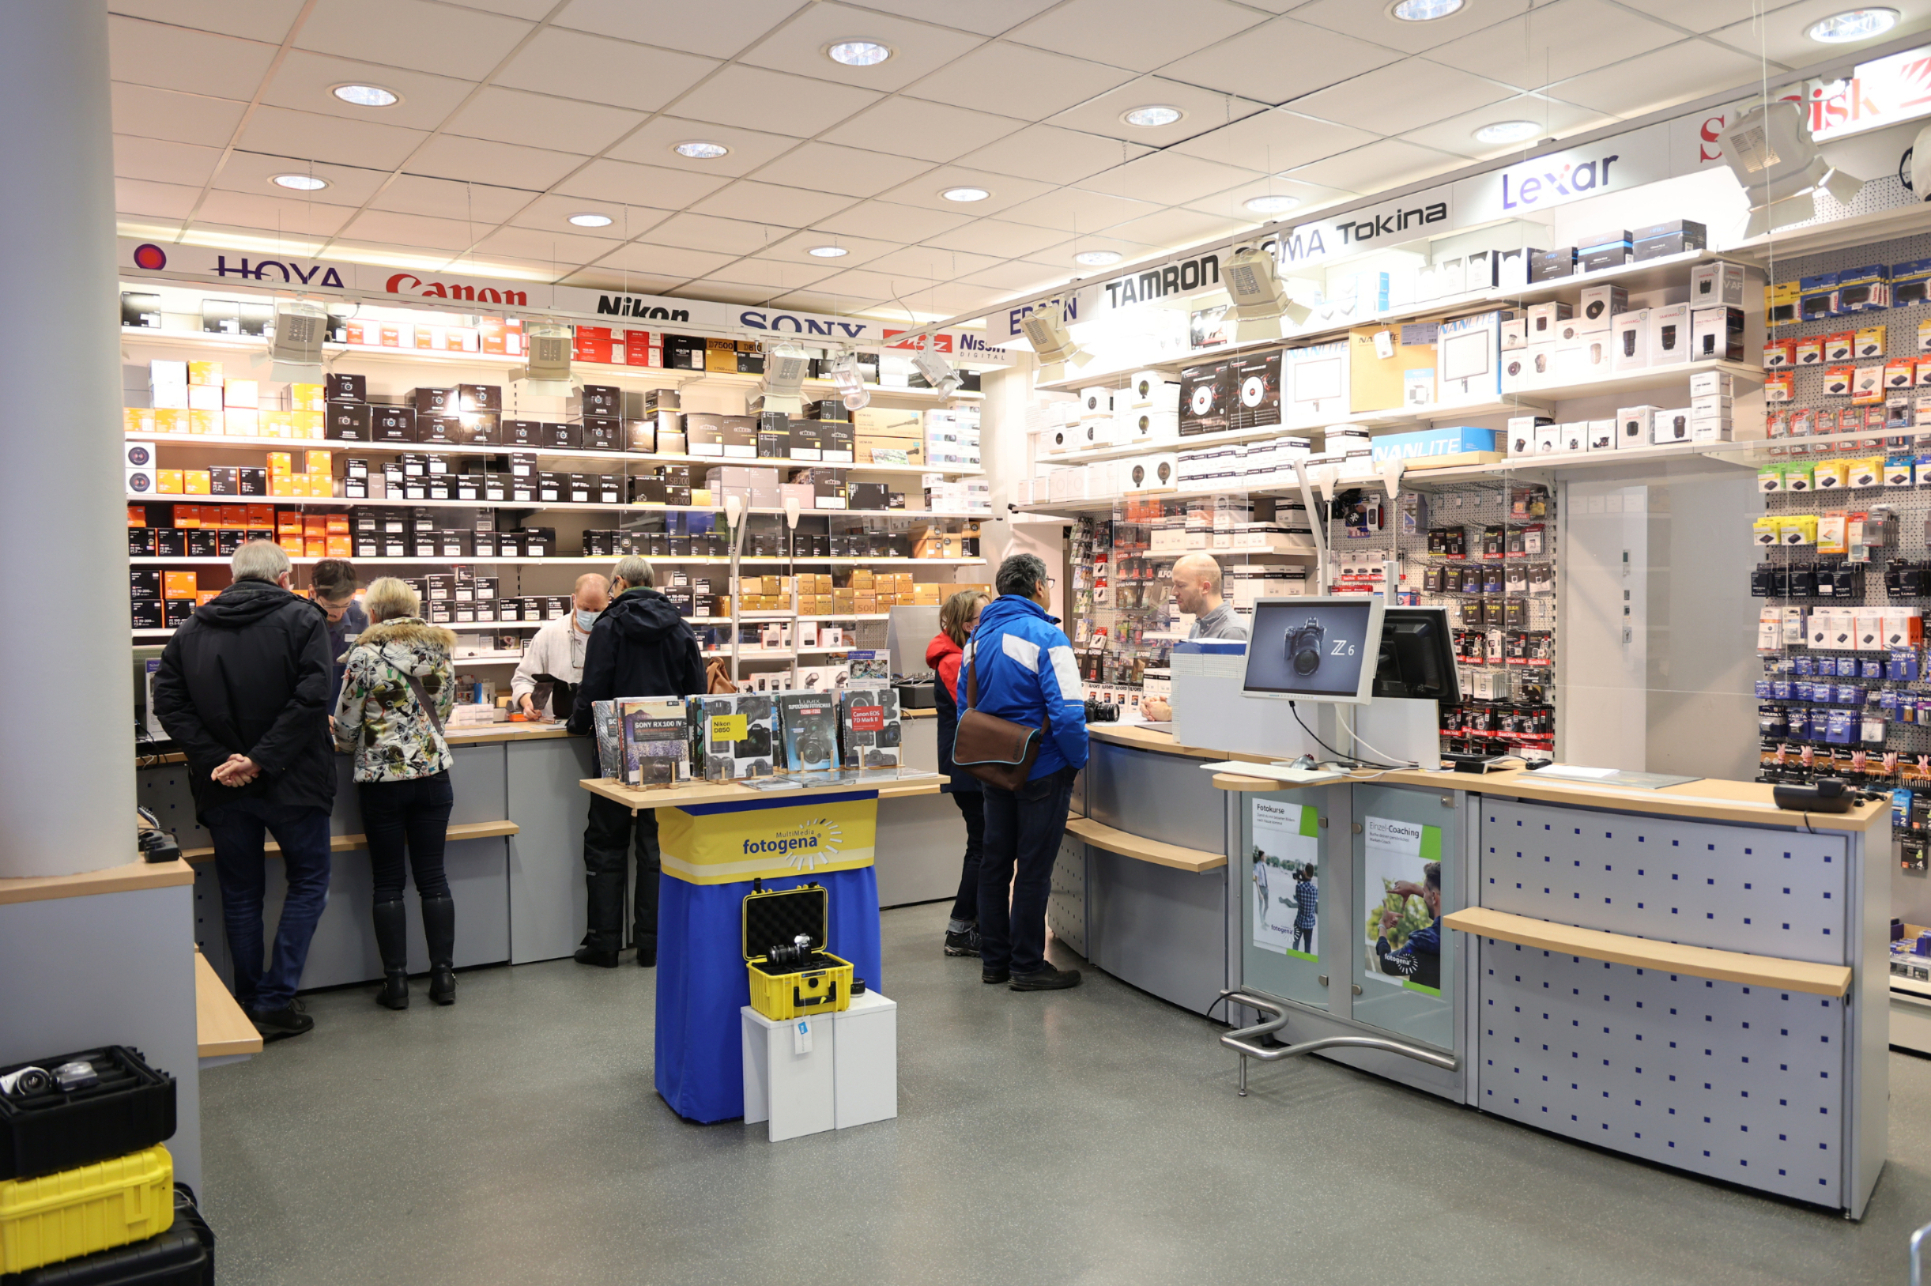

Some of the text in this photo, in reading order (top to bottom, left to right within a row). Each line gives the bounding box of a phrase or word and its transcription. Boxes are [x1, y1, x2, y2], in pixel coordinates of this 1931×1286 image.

[1502, 154, 1619, 210] Lexar
[1336, 202, 1447, 245] Tokina
[208, 255, 345, 289] HOYA
[385, 273, 527, 307] Canon
[1105, 254, 1219, 309] TAMRON
[596, 294, 690, 323] Nikon
[739, 311, 867, 339] SONY
[1438, 313, 1494, 335] NANLITE
[708, 341, 734, 350] D7500
[1286, 341, 1349, 359] NANLITE
[959, 351, 1006, 361] DIGITAL
[1373, 437, 1461, 461] NANLITE
[669, 477, 690, 485] SB700
[669, 497, 690, 505] SB700
[857, 605, 875, 613] 500
[1330, 639, 1355, 656] Z 6
[634, 721, 651, 729] SONY
[1256, 803, 1285, 814] Fotokurse
[1369, 821, 1420, 839] Einzel-Coaching
[1900, 817, 1907, 825] 2
[775, 829, 815, 838] MultiMedia
